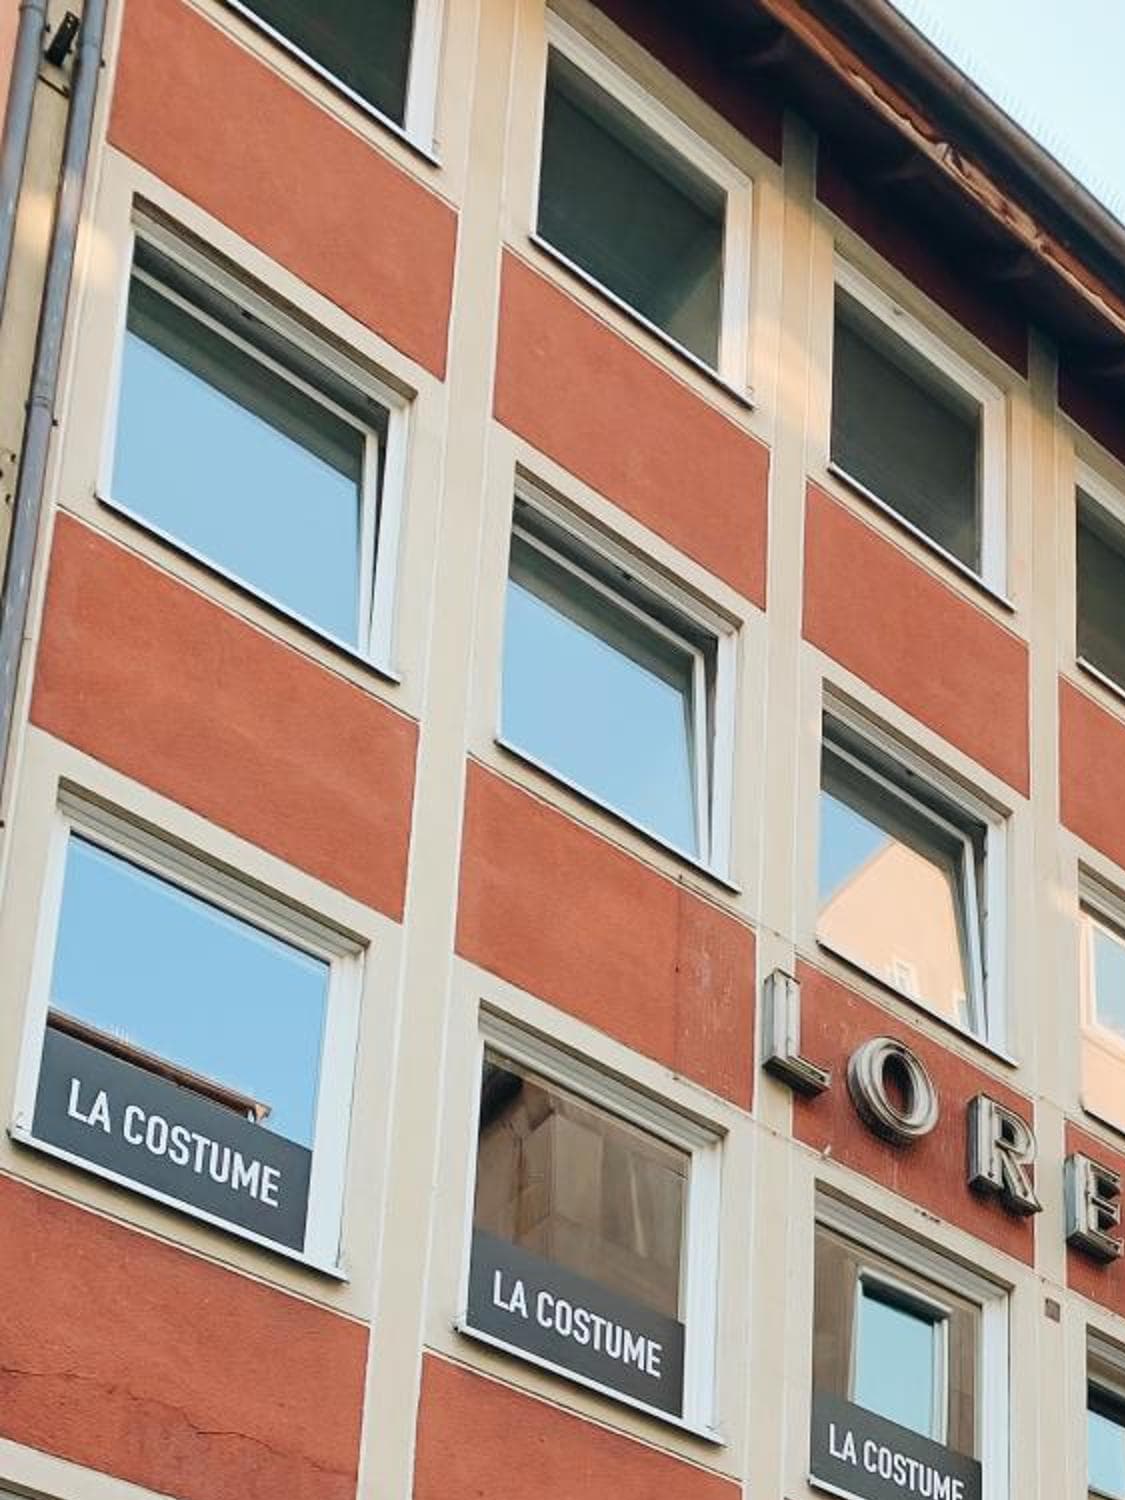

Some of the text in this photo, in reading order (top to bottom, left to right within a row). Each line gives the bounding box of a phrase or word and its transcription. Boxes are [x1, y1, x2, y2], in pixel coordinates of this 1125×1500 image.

[68, 1079, 282, 1209] LA COSTUME
[492, 1269, 663, 1379] LA COSTUME
[829, 1423, 857, 1461] LA
